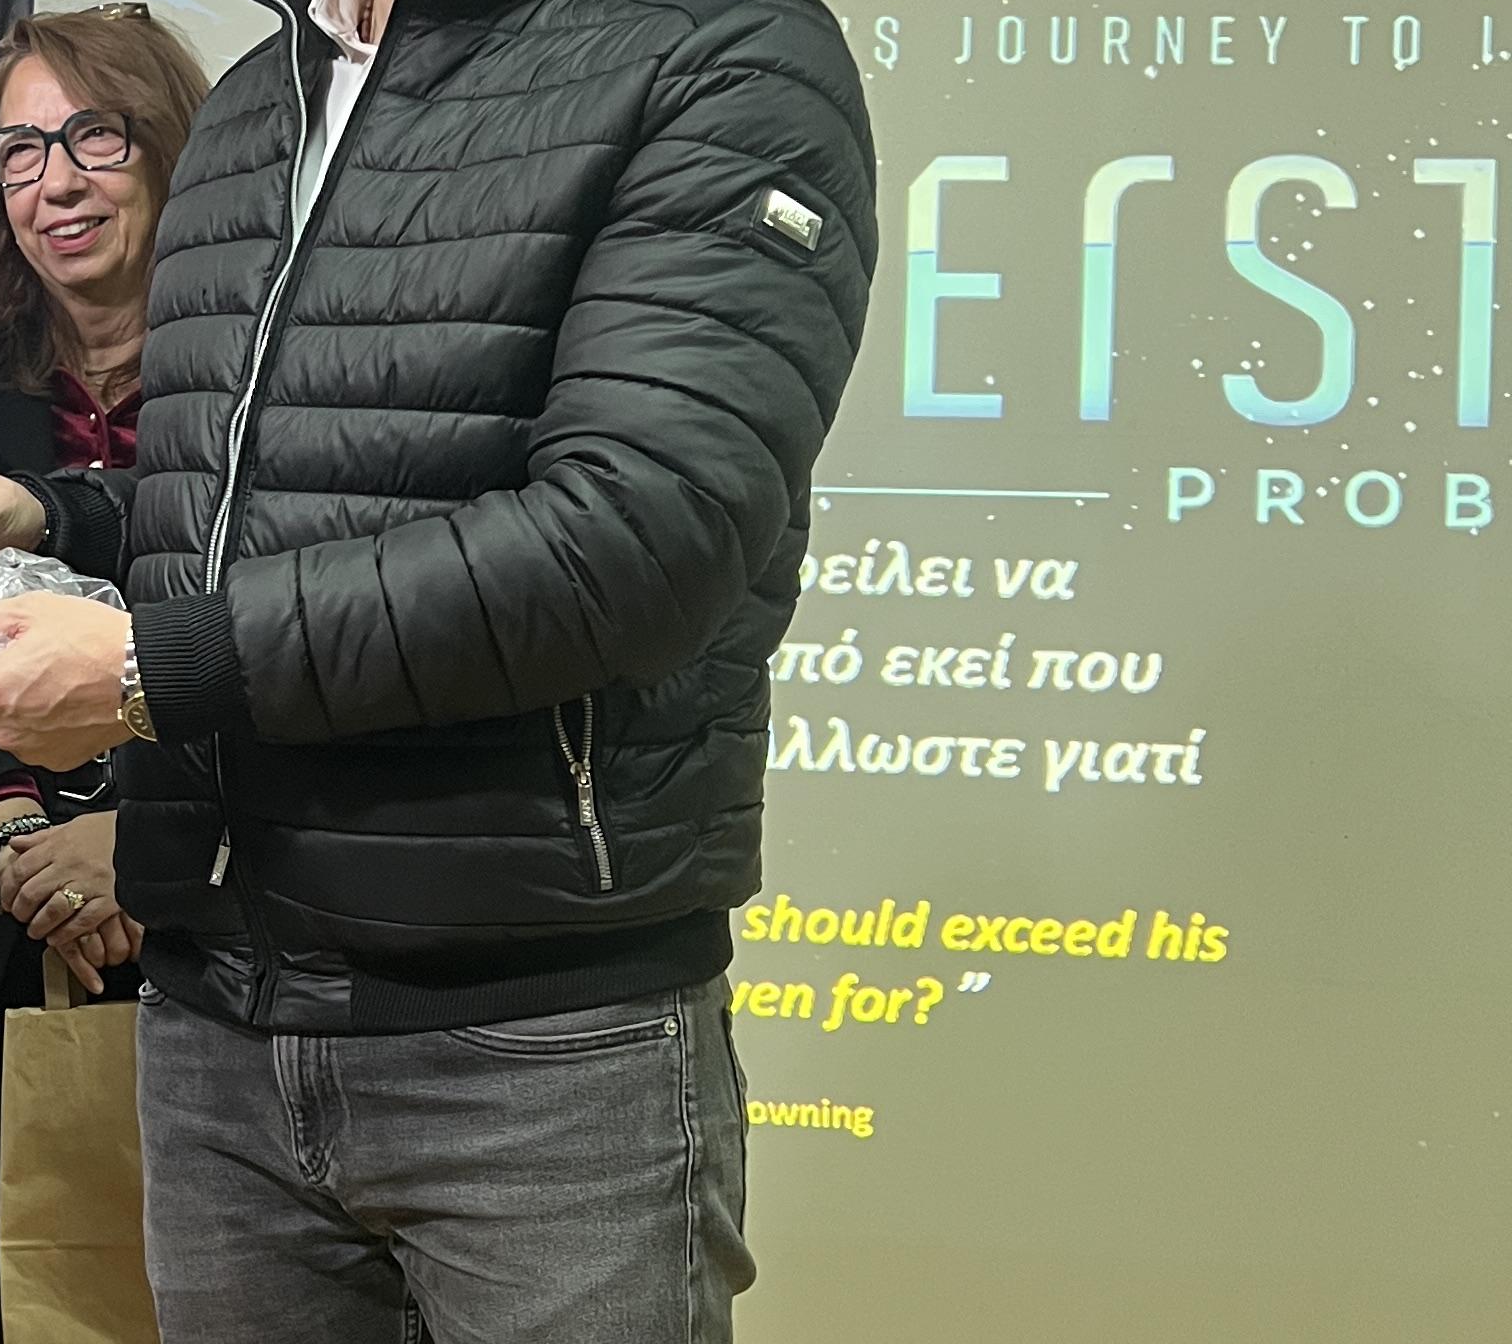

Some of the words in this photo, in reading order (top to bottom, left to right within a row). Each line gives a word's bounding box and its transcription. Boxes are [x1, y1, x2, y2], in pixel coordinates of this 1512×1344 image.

[954, 15, 1288, 64] JOURNEY
[1342, 15, 1421, 69] TO
[1166, 466, 1495, 530] PROB
[994, 557, 1080, 600] να
[767, 628, 864, 685] πό
[880, 632, 1017, 690] εκεί
[1027, 649, 1164, 695] που
[1044, 728, 1208, 793] γιατί
[741, 894, 931, 949] should
[940, 908, 1138, 959] exceed
[1146, 910, 1230, 962] his
[747, 1098, 875, 1138] owning
